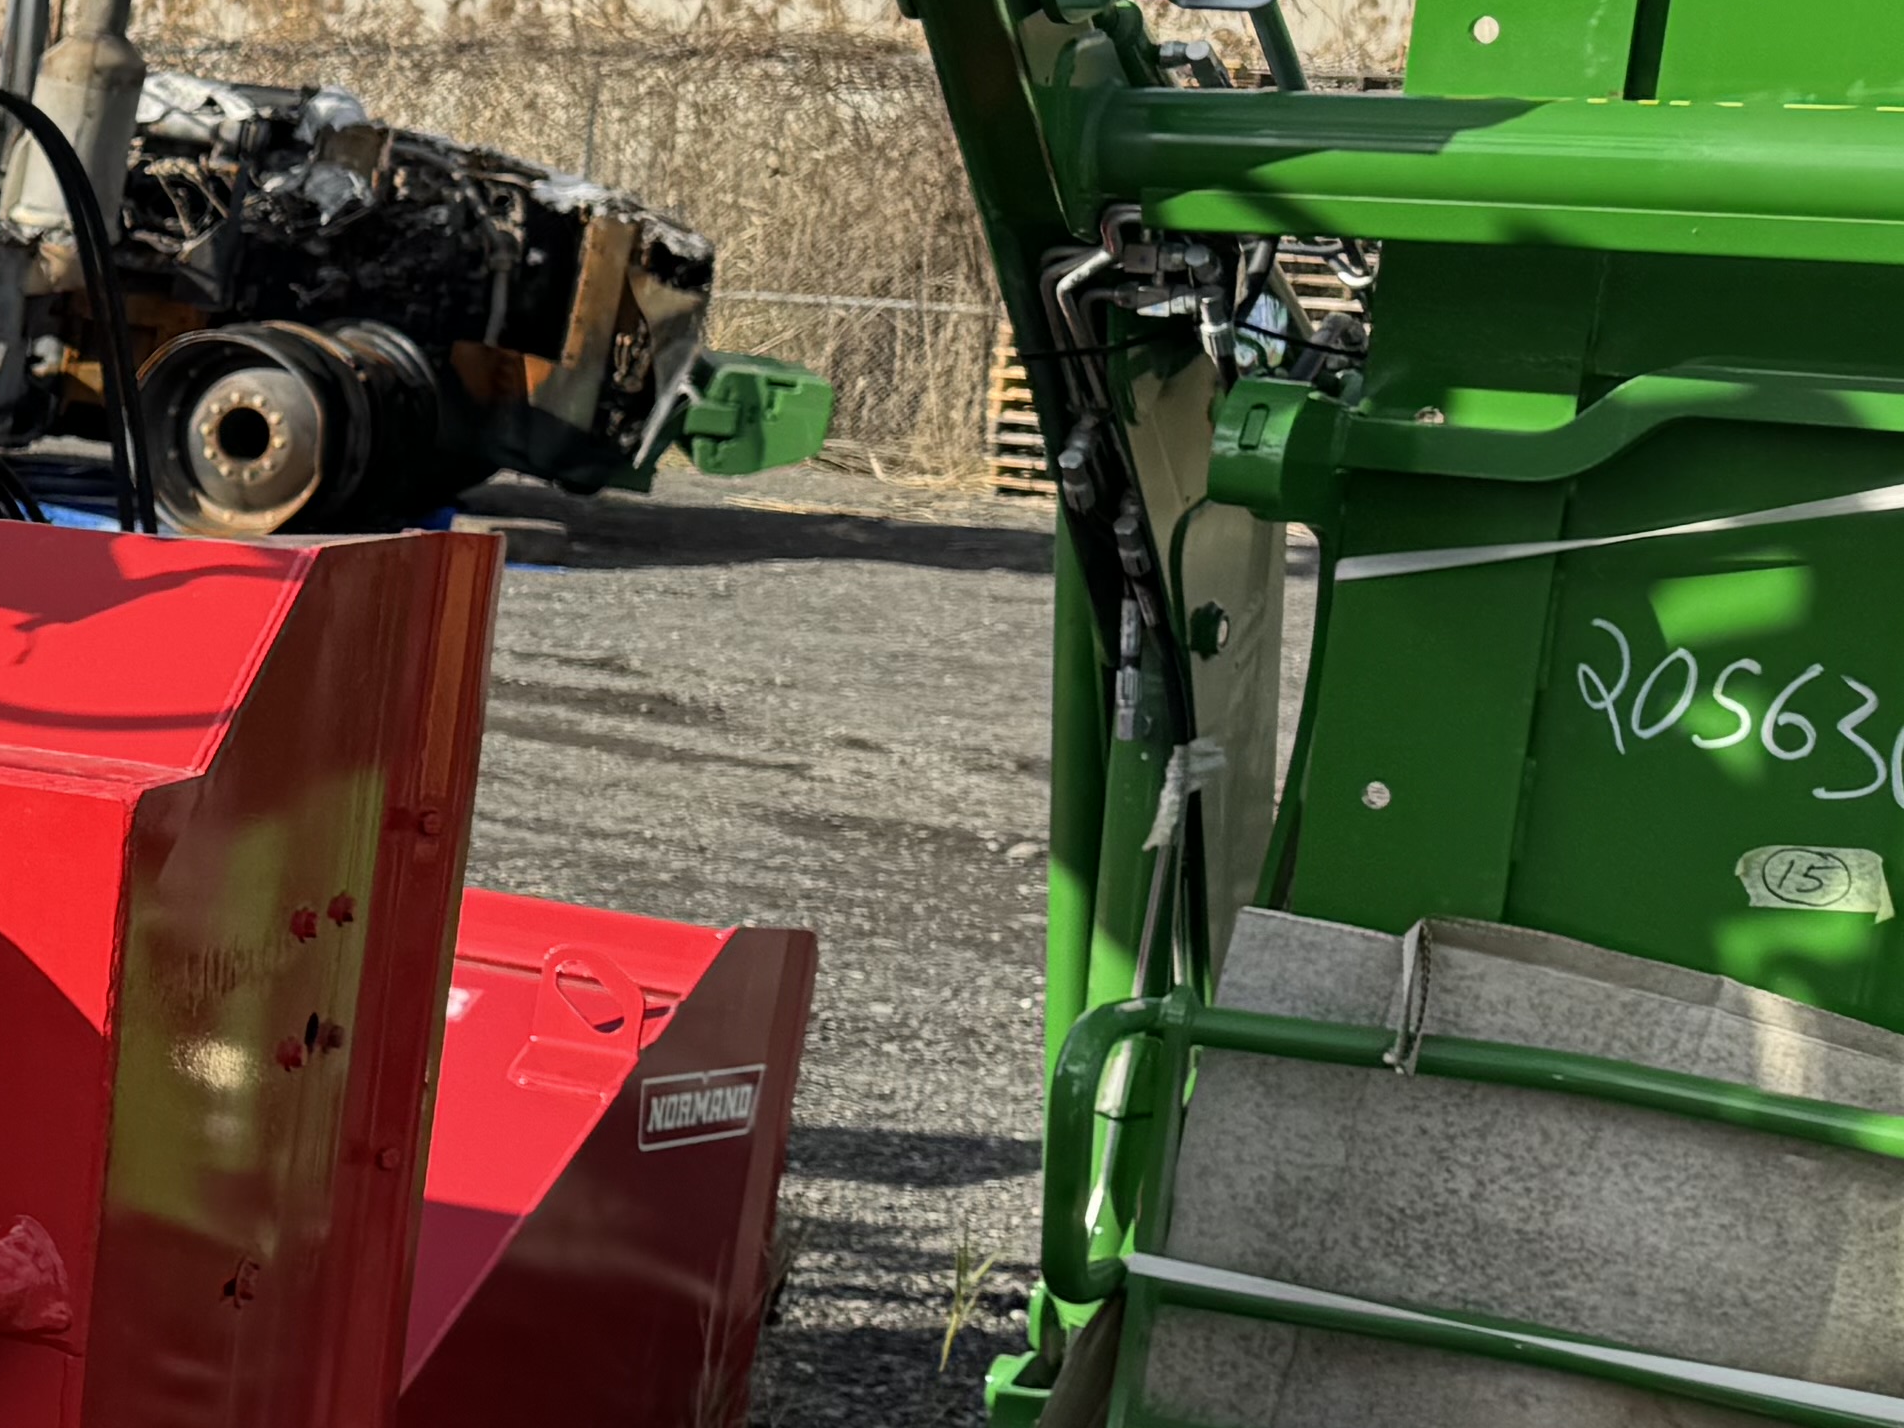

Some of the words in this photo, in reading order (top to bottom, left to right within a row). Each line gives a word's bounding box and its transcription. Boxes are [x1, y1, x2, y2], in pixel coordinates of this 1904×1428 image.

[1576, 617, 1904, 810] 20563
[1776, 860, 1843, 893] 15
[646, 1083, 754, 1133] NORMAND
